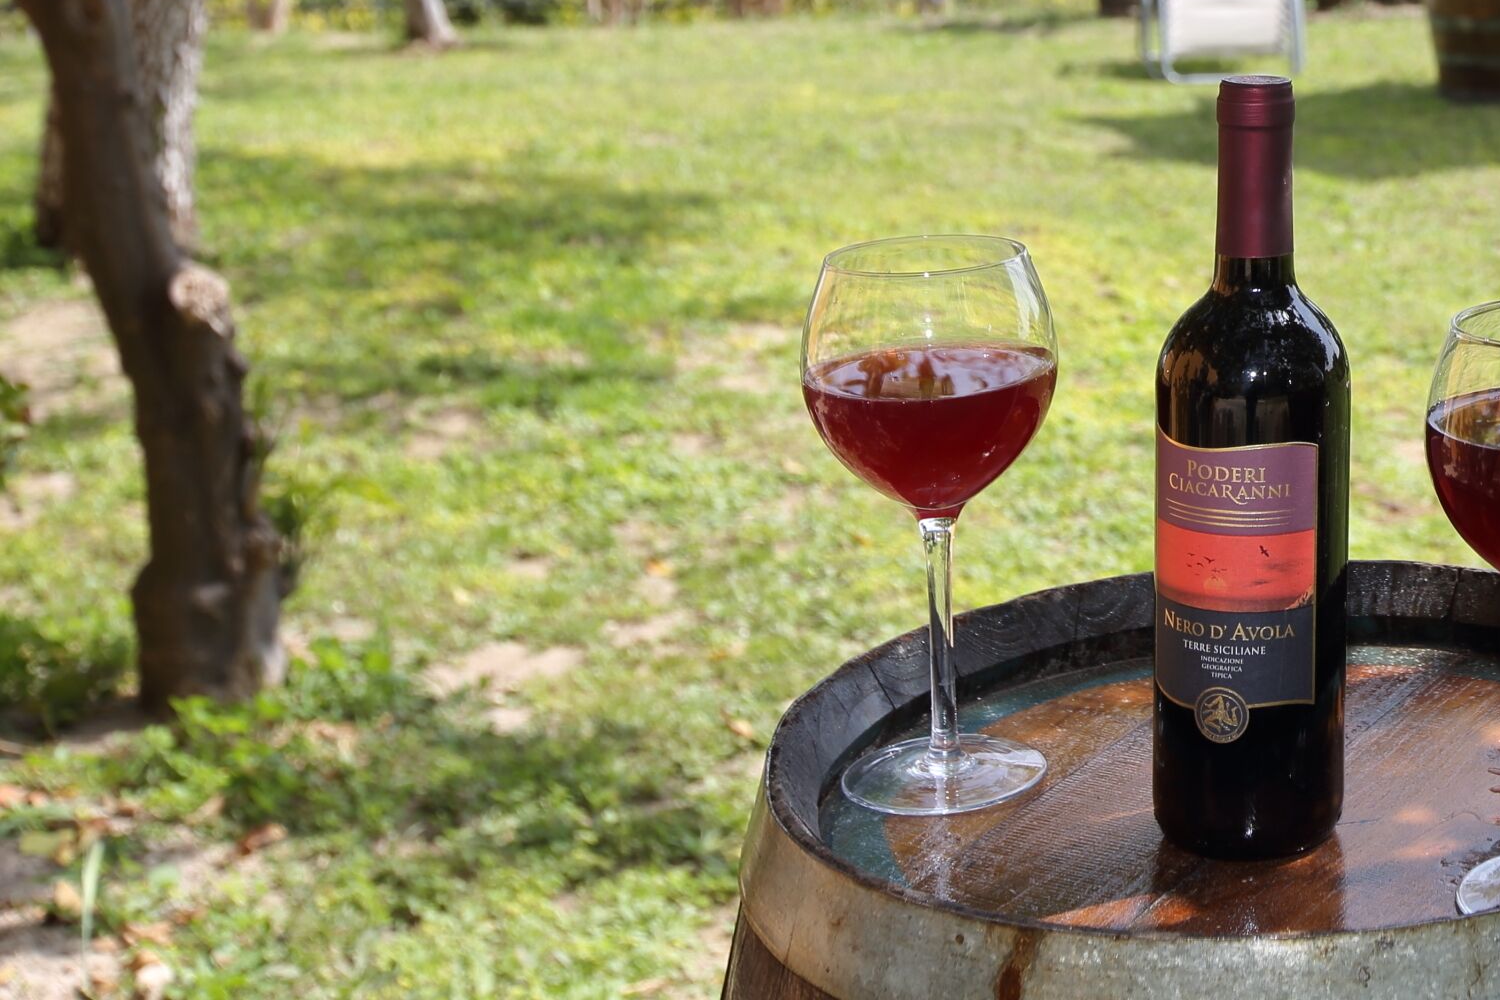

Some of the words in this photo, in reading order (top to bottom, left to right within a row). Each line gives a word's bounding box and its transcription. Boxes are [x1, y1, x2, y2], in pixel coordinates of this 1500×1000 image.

[1187, 459, 1266, 483] PODERI
[1169, 472, 1291, 505] CIACARANNI
[1164, 608, 1205, 637] NERO
[1183, 639, 1211, 654] TERRE
[1213, 645, 1266, 656] SICILIANE
[1200, 655, 1244, 665] INDICAZIONE
[1201, 663, 1243, 672] GEOGRAFICA
[1211, 671, 1232, 680] TIPICA
